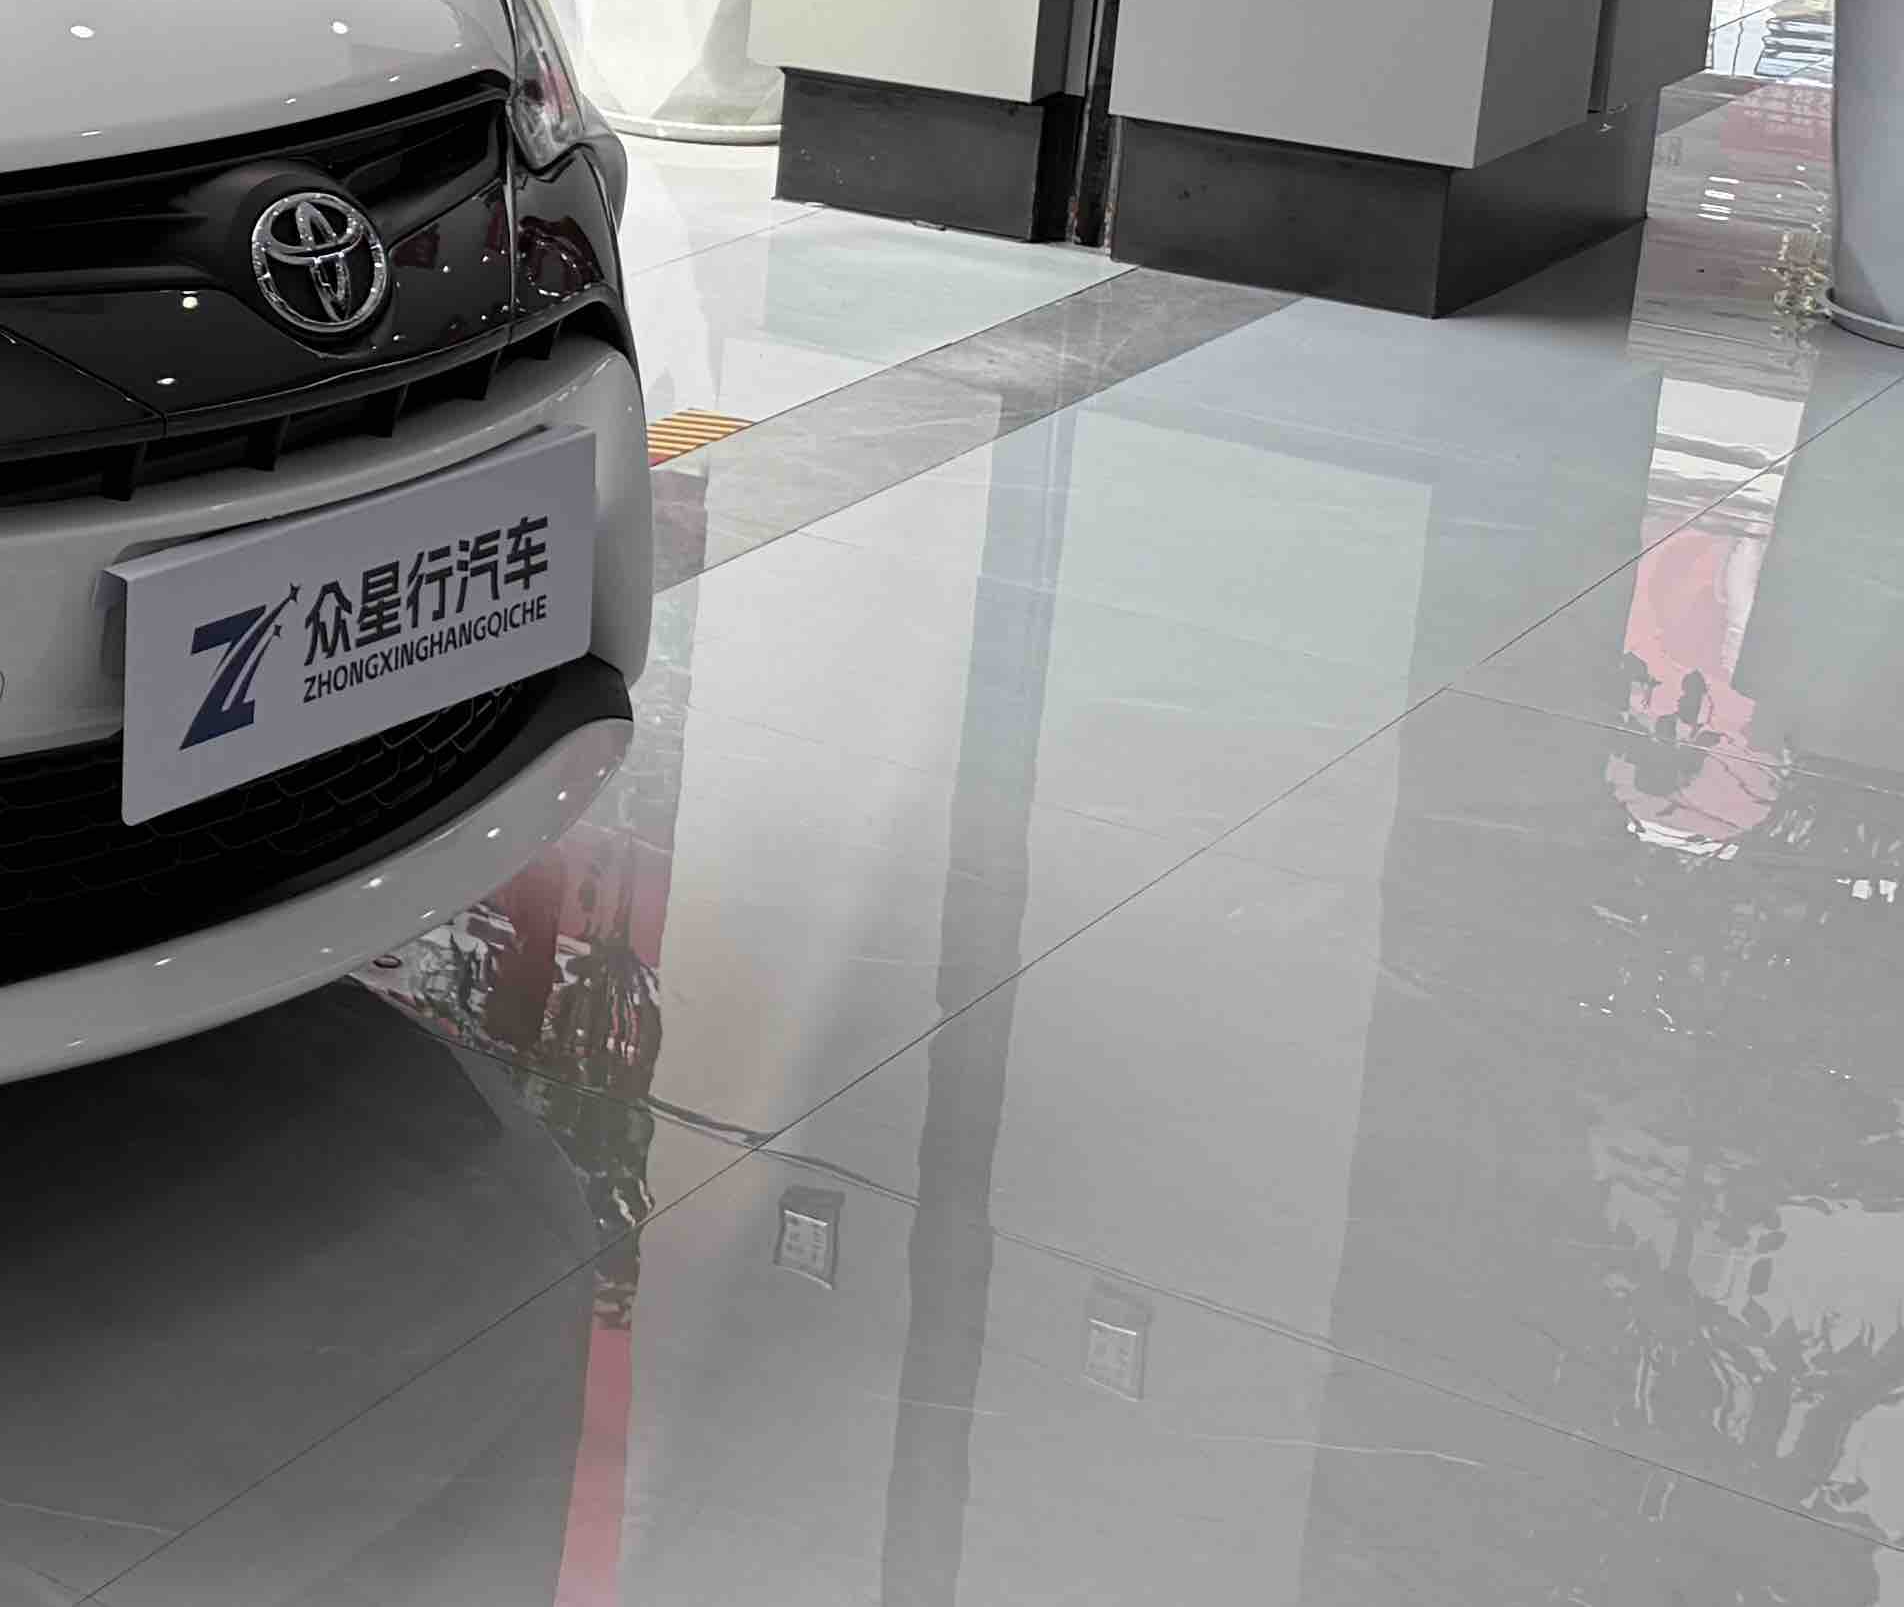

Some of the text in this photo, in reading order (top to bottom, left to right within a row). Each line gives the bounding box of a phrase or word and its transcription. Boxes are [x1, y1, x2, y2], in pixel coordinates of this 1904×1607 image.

[302, 594, 548, 704] ZHONGXINGHANGQICHE
[303, 515, 549, 667] 众星行汽车
